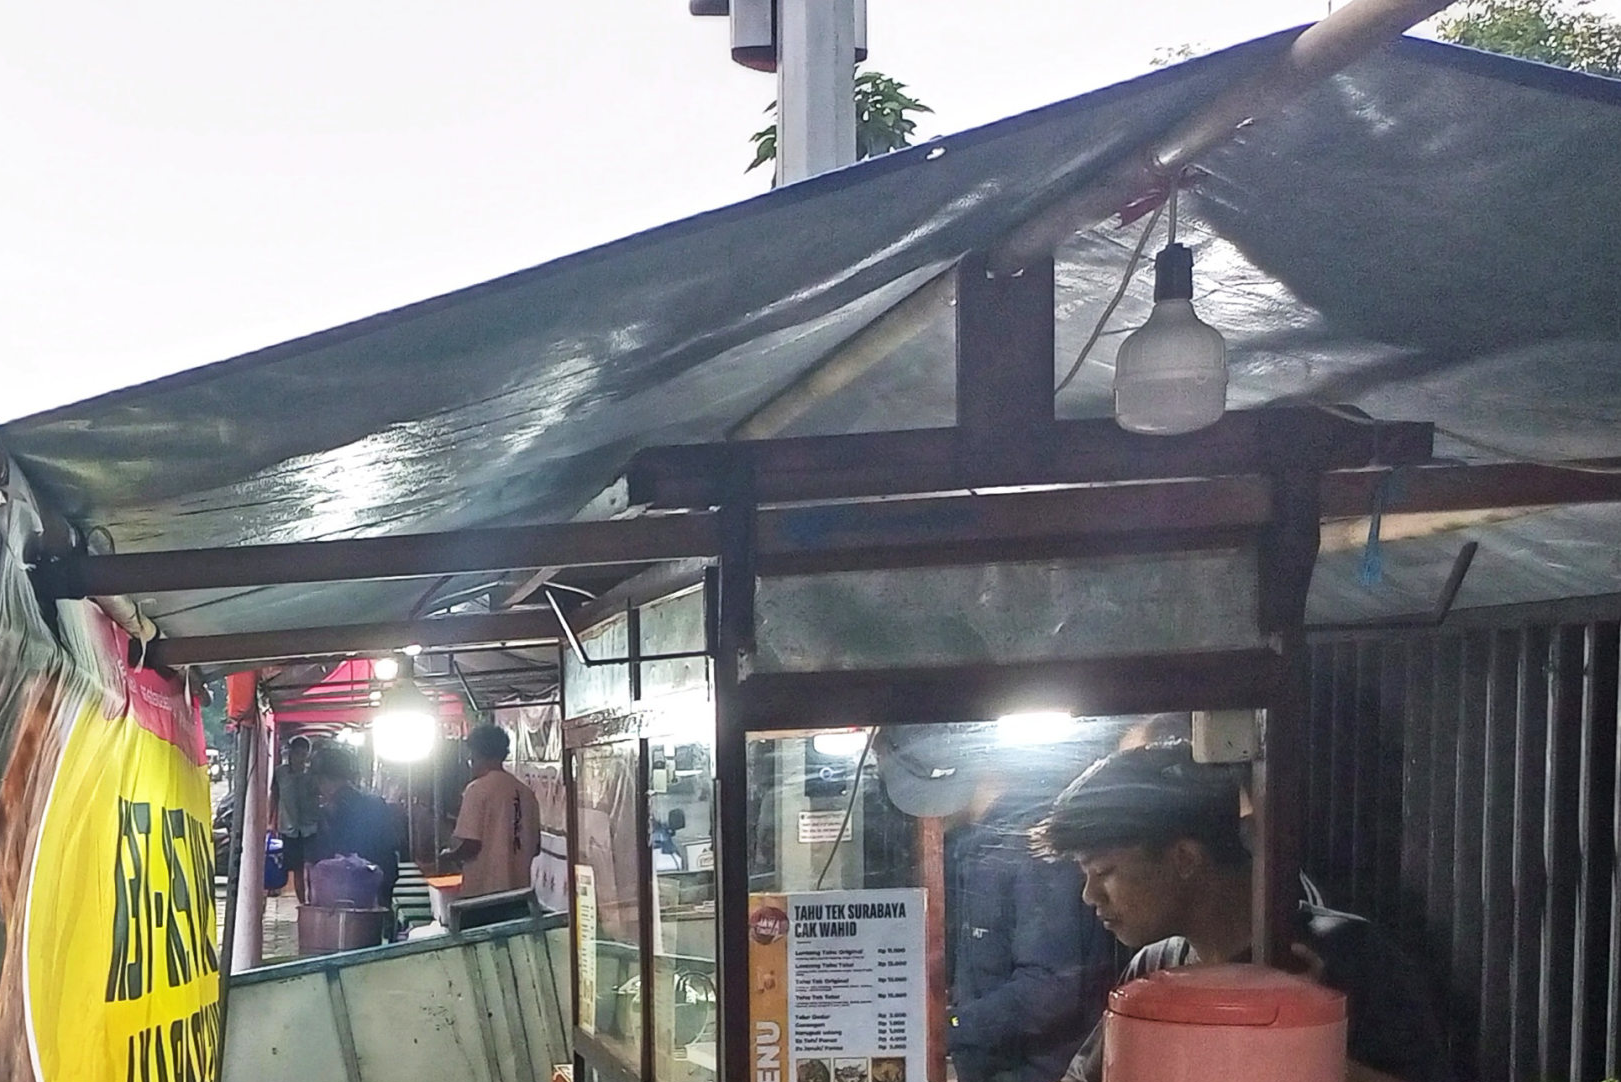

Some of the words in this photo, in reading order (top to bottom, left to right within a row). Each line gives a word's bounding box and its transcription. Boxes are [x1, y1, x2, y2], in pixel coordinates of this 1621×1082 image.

[794, 904, 823, 921] TAHU
[825, 904, 846, 920] TEK
[848, 902, 906, 919] SURABAYA
[794, 922, 818, 938] CAK
[820, 921, 857, 937] WAHID
